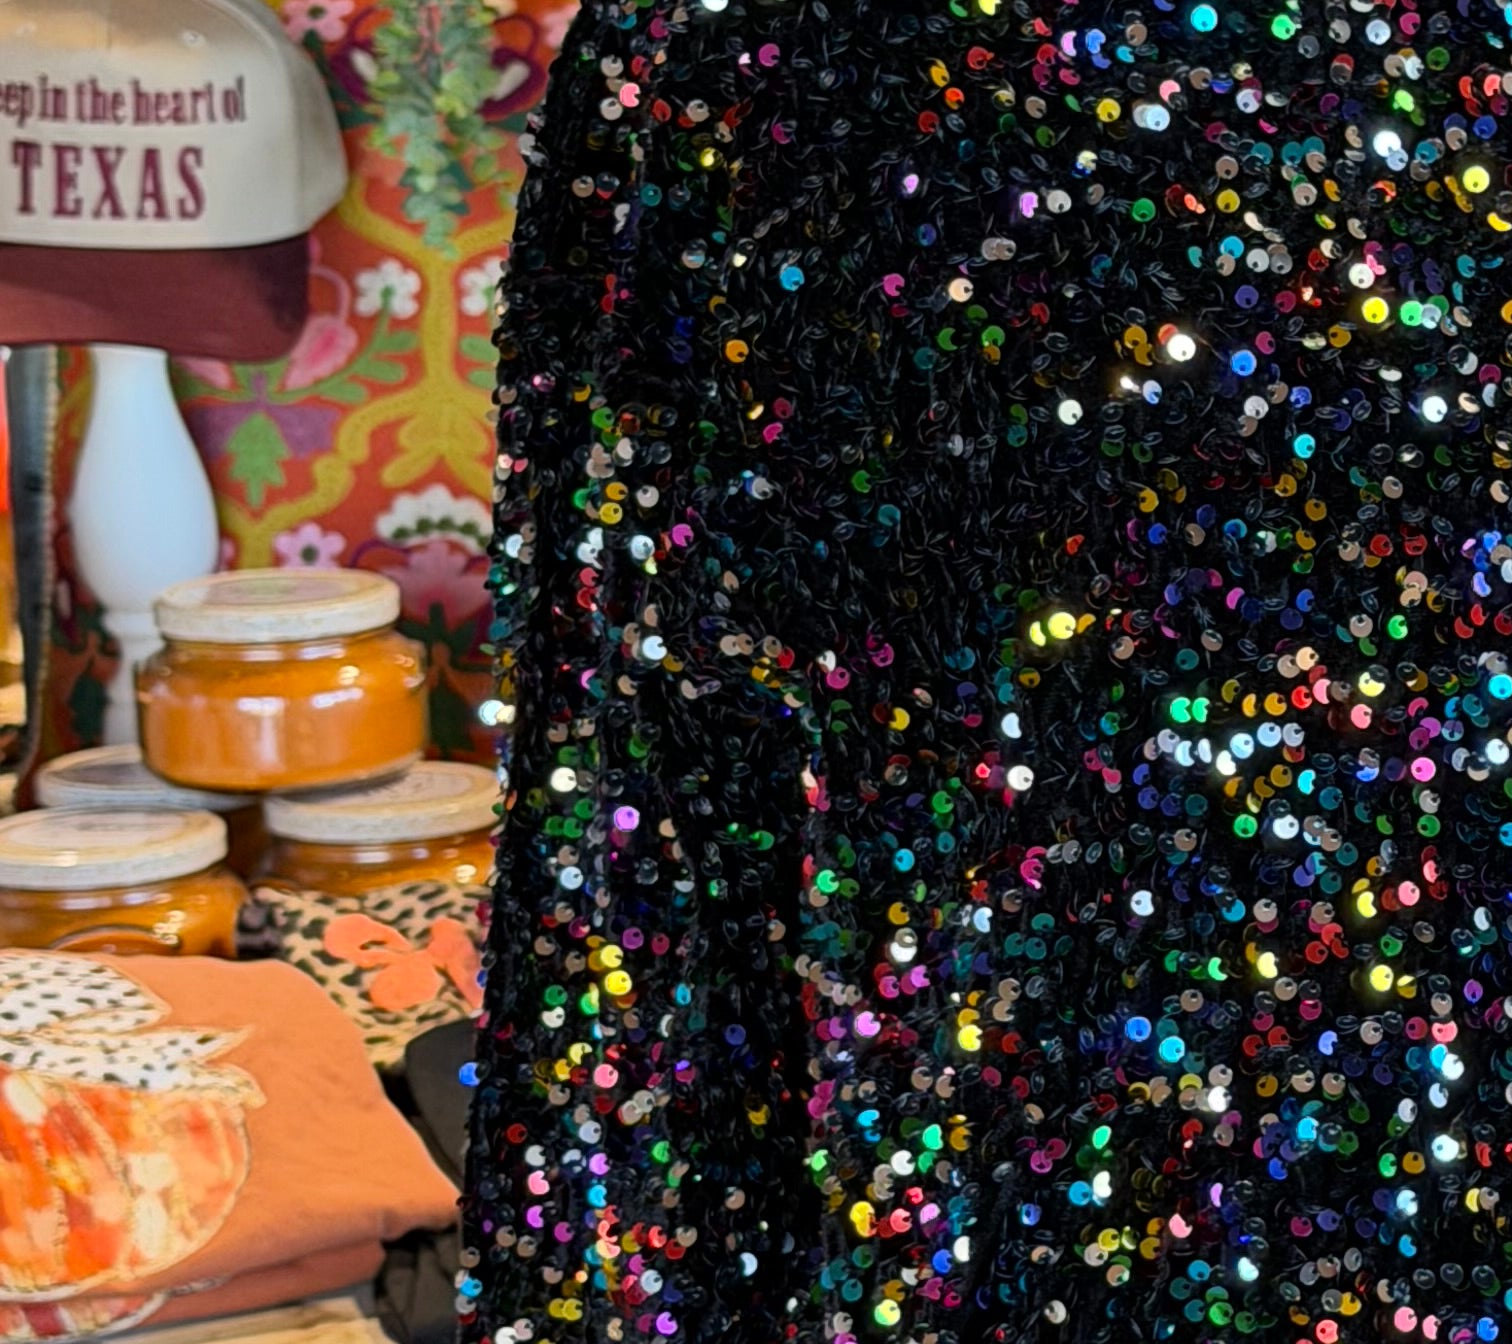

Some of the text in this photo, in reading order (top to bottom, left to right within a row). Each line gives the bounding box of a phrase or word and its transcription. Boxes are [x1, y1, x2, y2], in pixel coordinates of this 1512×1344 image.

[38, 73, 68, 122] in
[75, 76, 127, 125] the
[131, 77, 217, 125] heart
[11, 138, 206, 220] TEXAS
